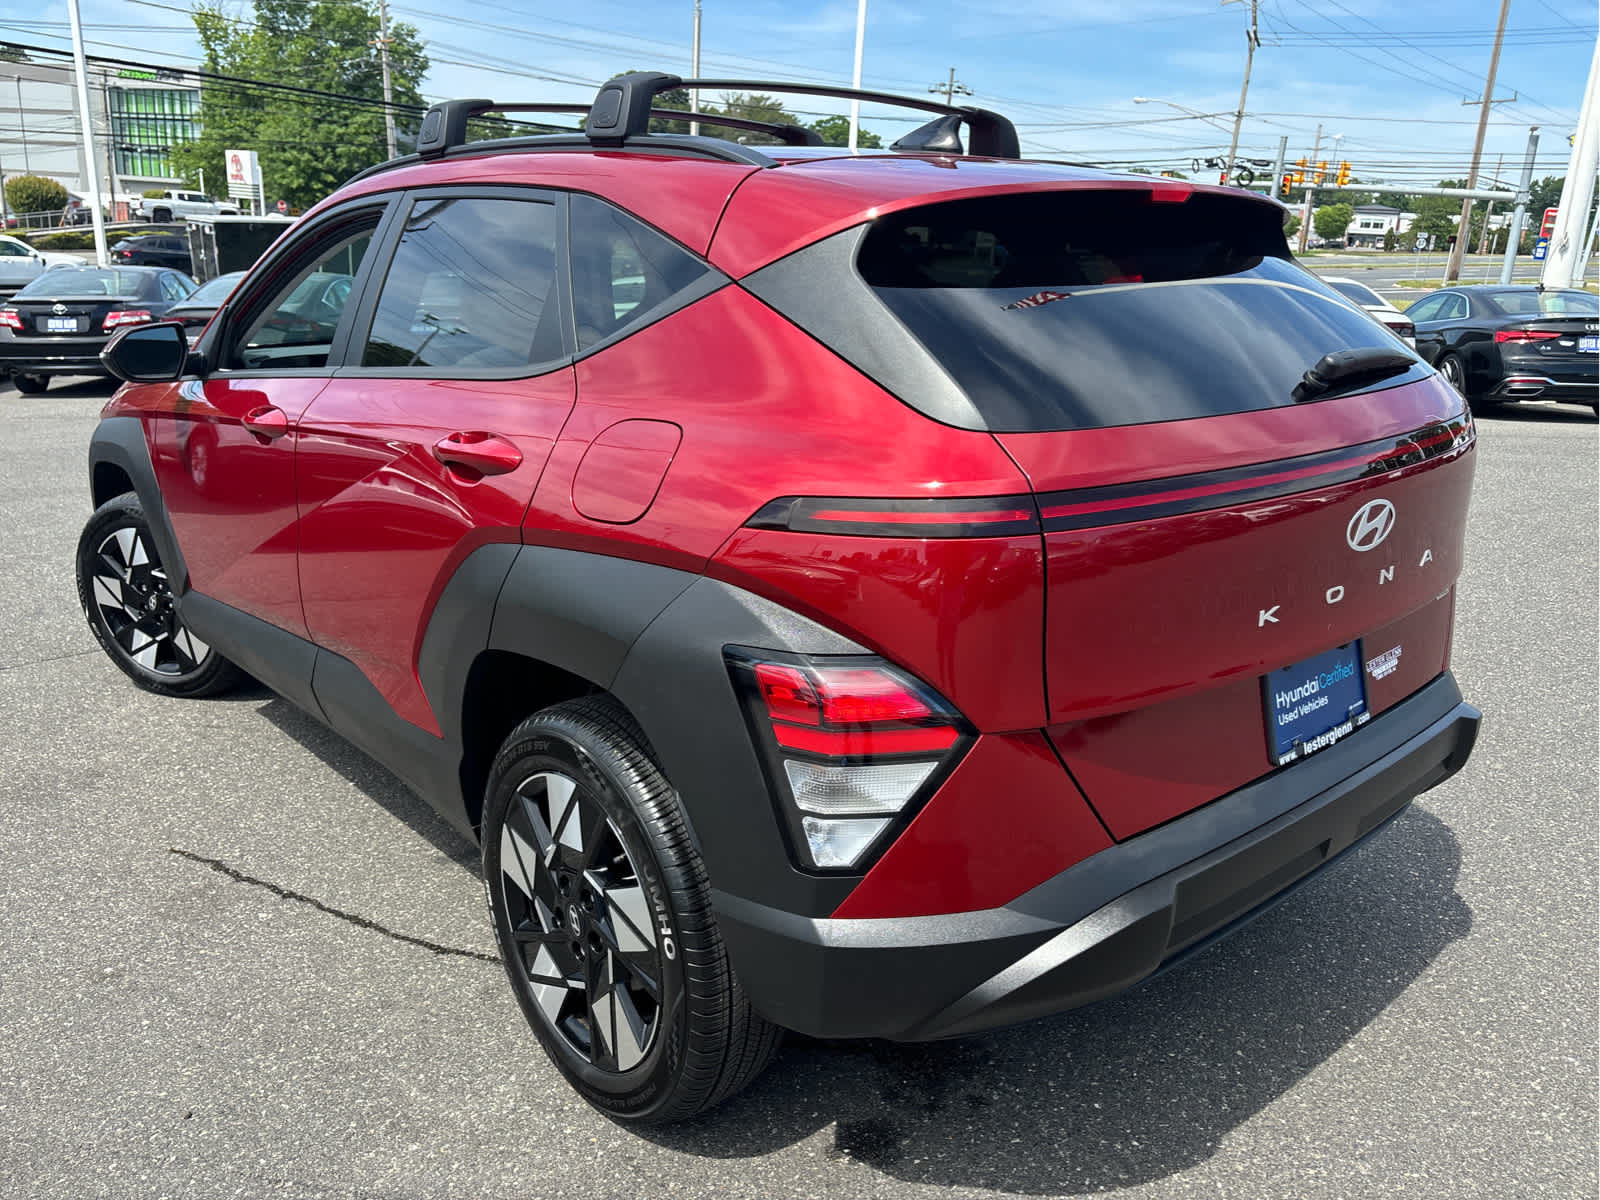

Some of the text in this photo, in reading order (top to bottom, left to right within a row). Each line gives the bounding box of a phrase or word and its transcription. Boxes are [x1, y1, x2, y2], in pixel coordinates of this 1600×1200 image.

[1258, 549, 1433, 627] KONA
[1275, 676, 1319, 709] Hyundai
[1319, 660, 1354, 689] Certified
[1278, 695, 1329, 726] Used Vehicles
[1303, 721, 1353, 755] lesterglenn
[643, 862, 676, 961] UMHO
